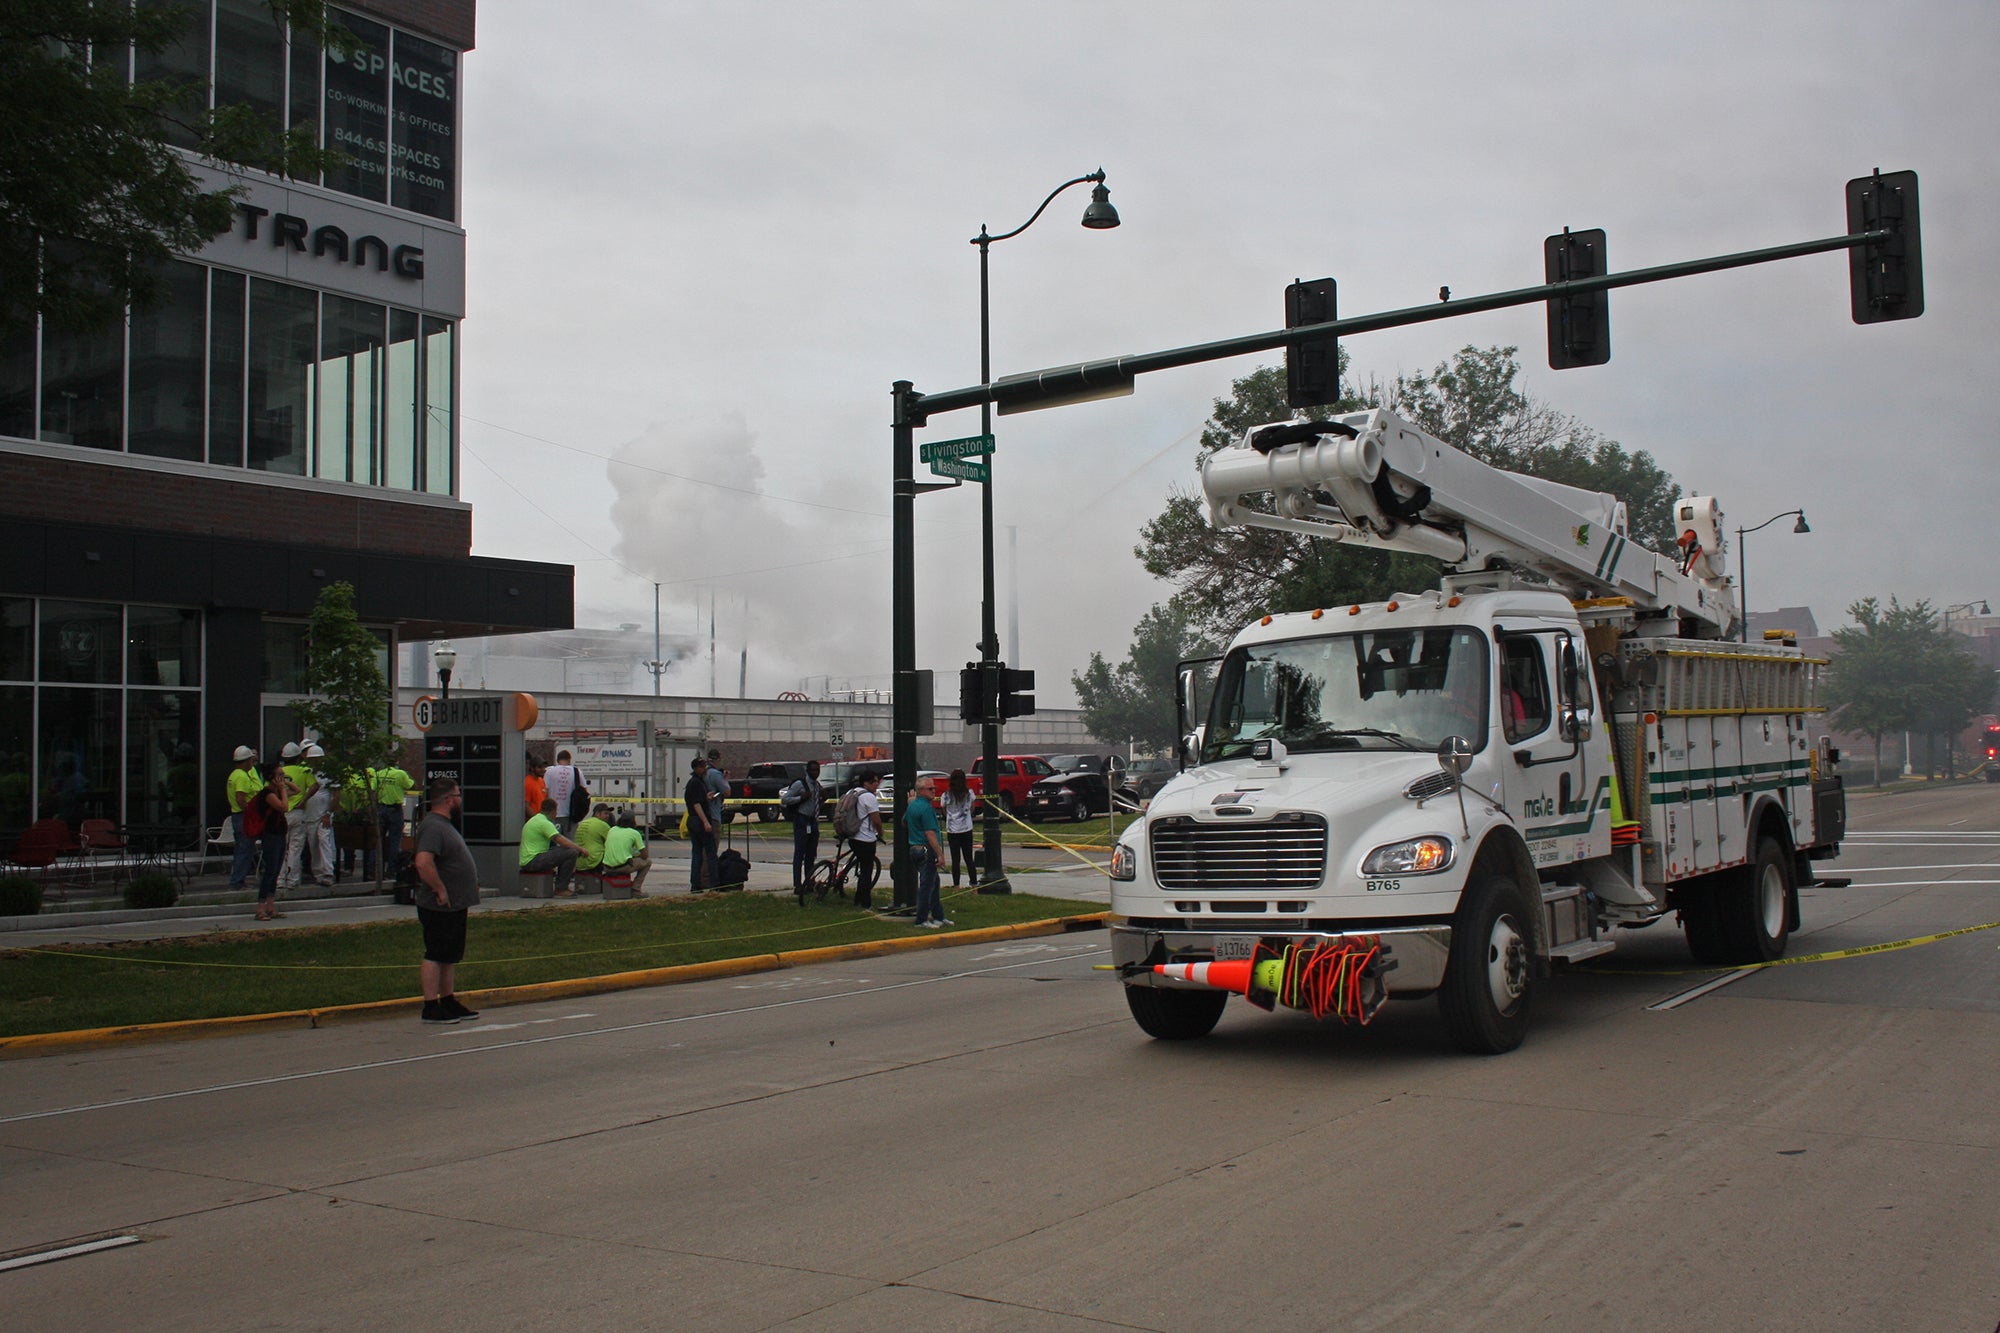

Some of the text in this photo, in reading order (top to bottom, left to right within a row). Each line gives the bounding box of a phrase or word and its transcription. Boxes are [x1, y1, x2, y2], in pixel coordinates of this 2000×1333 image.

[353, 50, 450, 100] SPACES.
[327, 88, 451, 136] CO-WORKING & OFFICES
[200, 193, 424, 280] TRANG
[928, 440, 982, 458] Livingston
[937, 458, 979, 479] Washington
[420, 700, 501, 725] GEBHARDT
[831, 735, 843, 745] 25
[1366, 880, 1400, 891] B765
[1224, 943, 1250, 955] 13766
